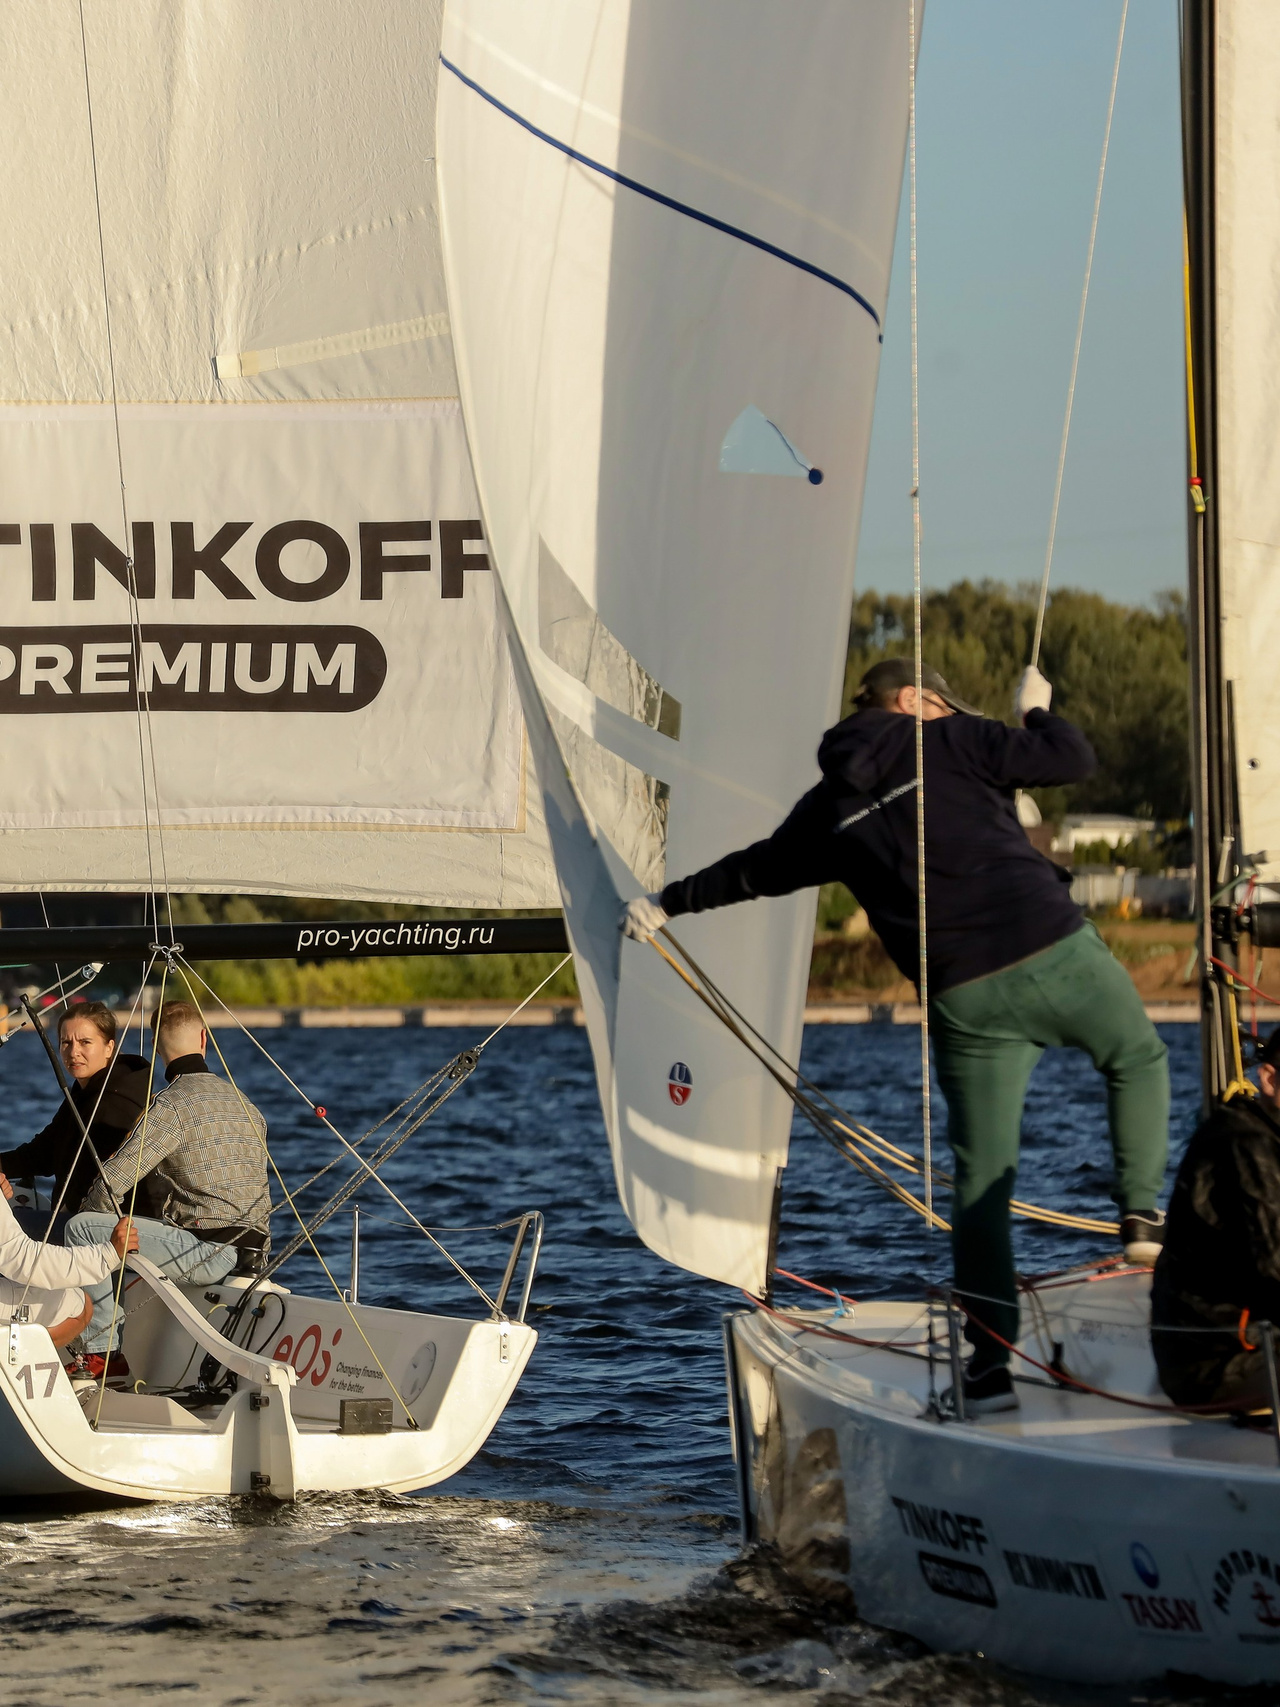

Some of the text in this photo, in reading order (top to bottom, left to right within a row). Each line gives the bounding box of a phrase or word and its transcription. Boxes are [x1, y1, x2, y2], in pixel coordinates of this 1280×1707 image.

[296, 922, 495, 952] pro-yachting.ru
[15, 1361, 60, 1400] 17
[329, 1378, 339, 1389] for
[338, 1381, 348, 1391] the
[336, 1362, 384, 1380] Changing finances
[891, 1496, 989, 1556] TINKOFF
[1122, 1593, 1204, 1632] TASSAY
